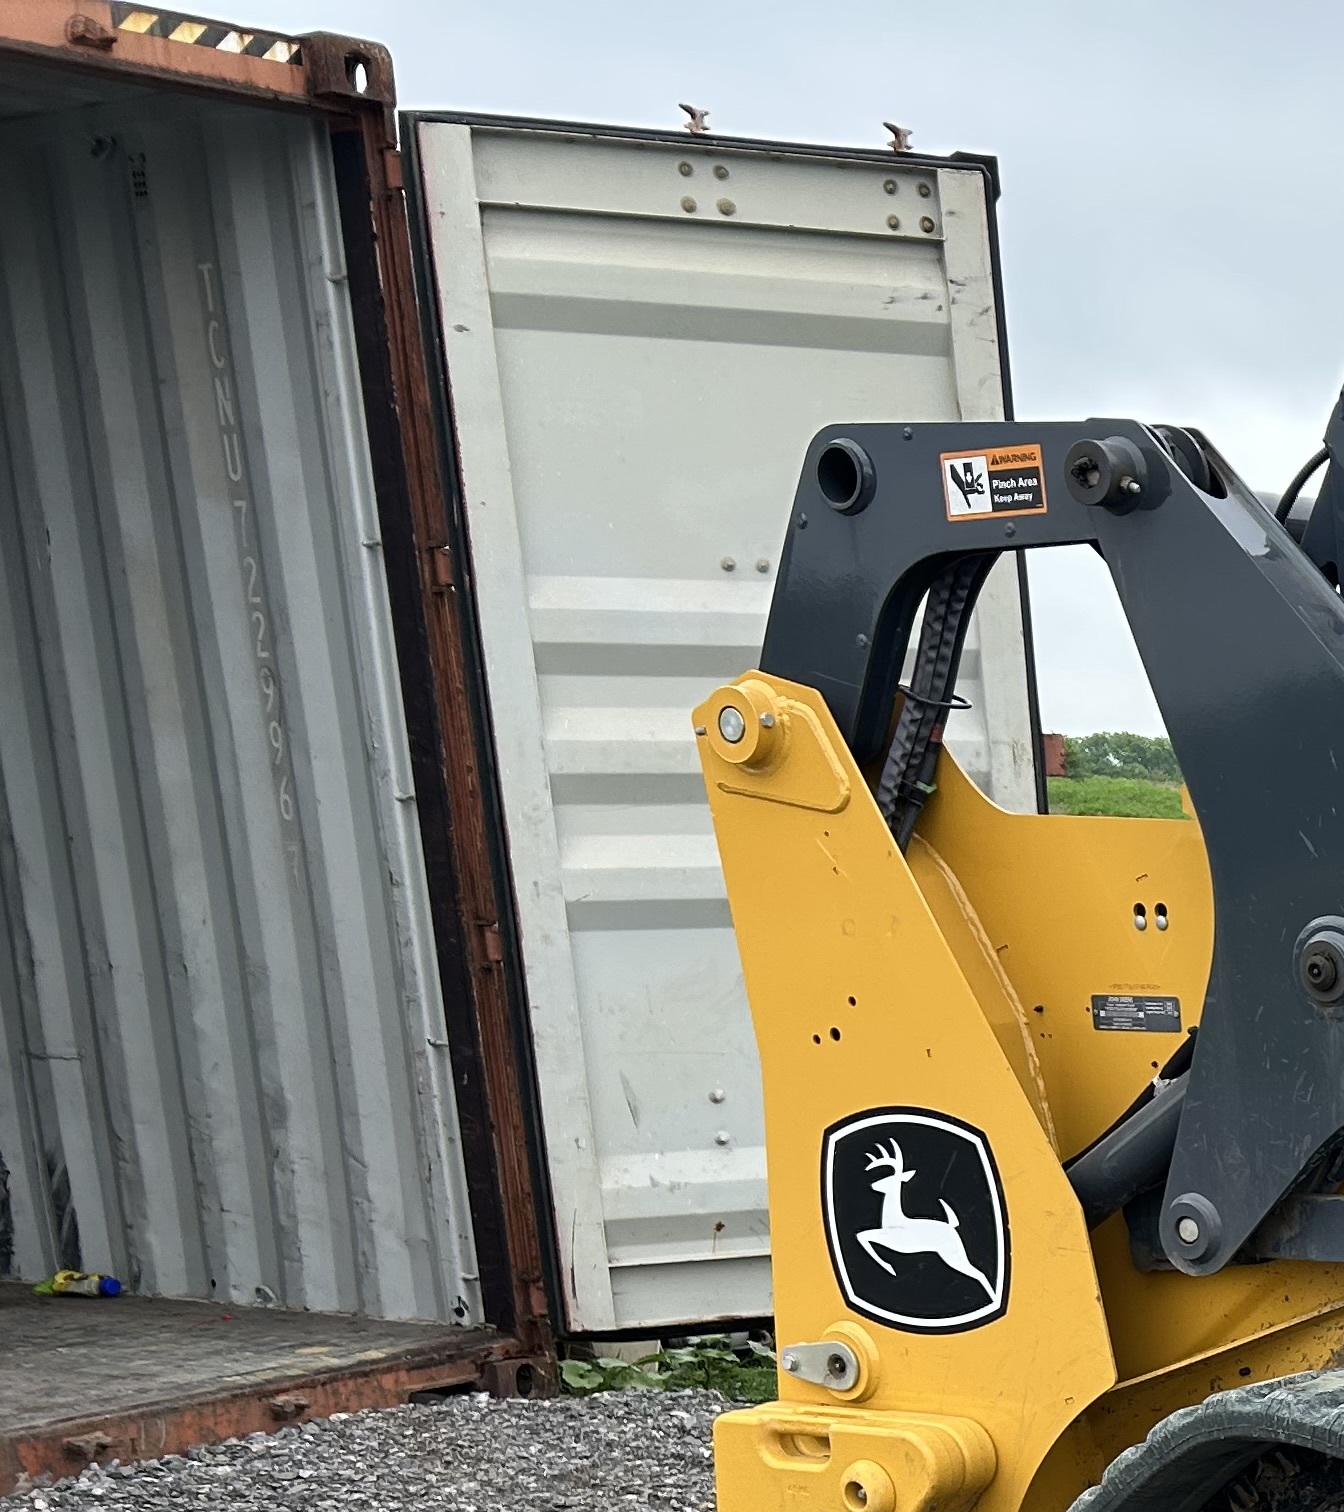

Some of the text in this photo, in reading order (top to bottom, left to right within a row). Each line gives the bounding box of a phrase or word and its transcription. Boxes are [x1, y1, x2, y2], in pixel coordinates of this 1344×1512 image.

[197, 263, 242, 482] TCNU
[998, 452, 1037, 464] WARNING
[992, 477, 1038, 489] Pinch Area
[994, 492, 1033, 504] Keep Away
